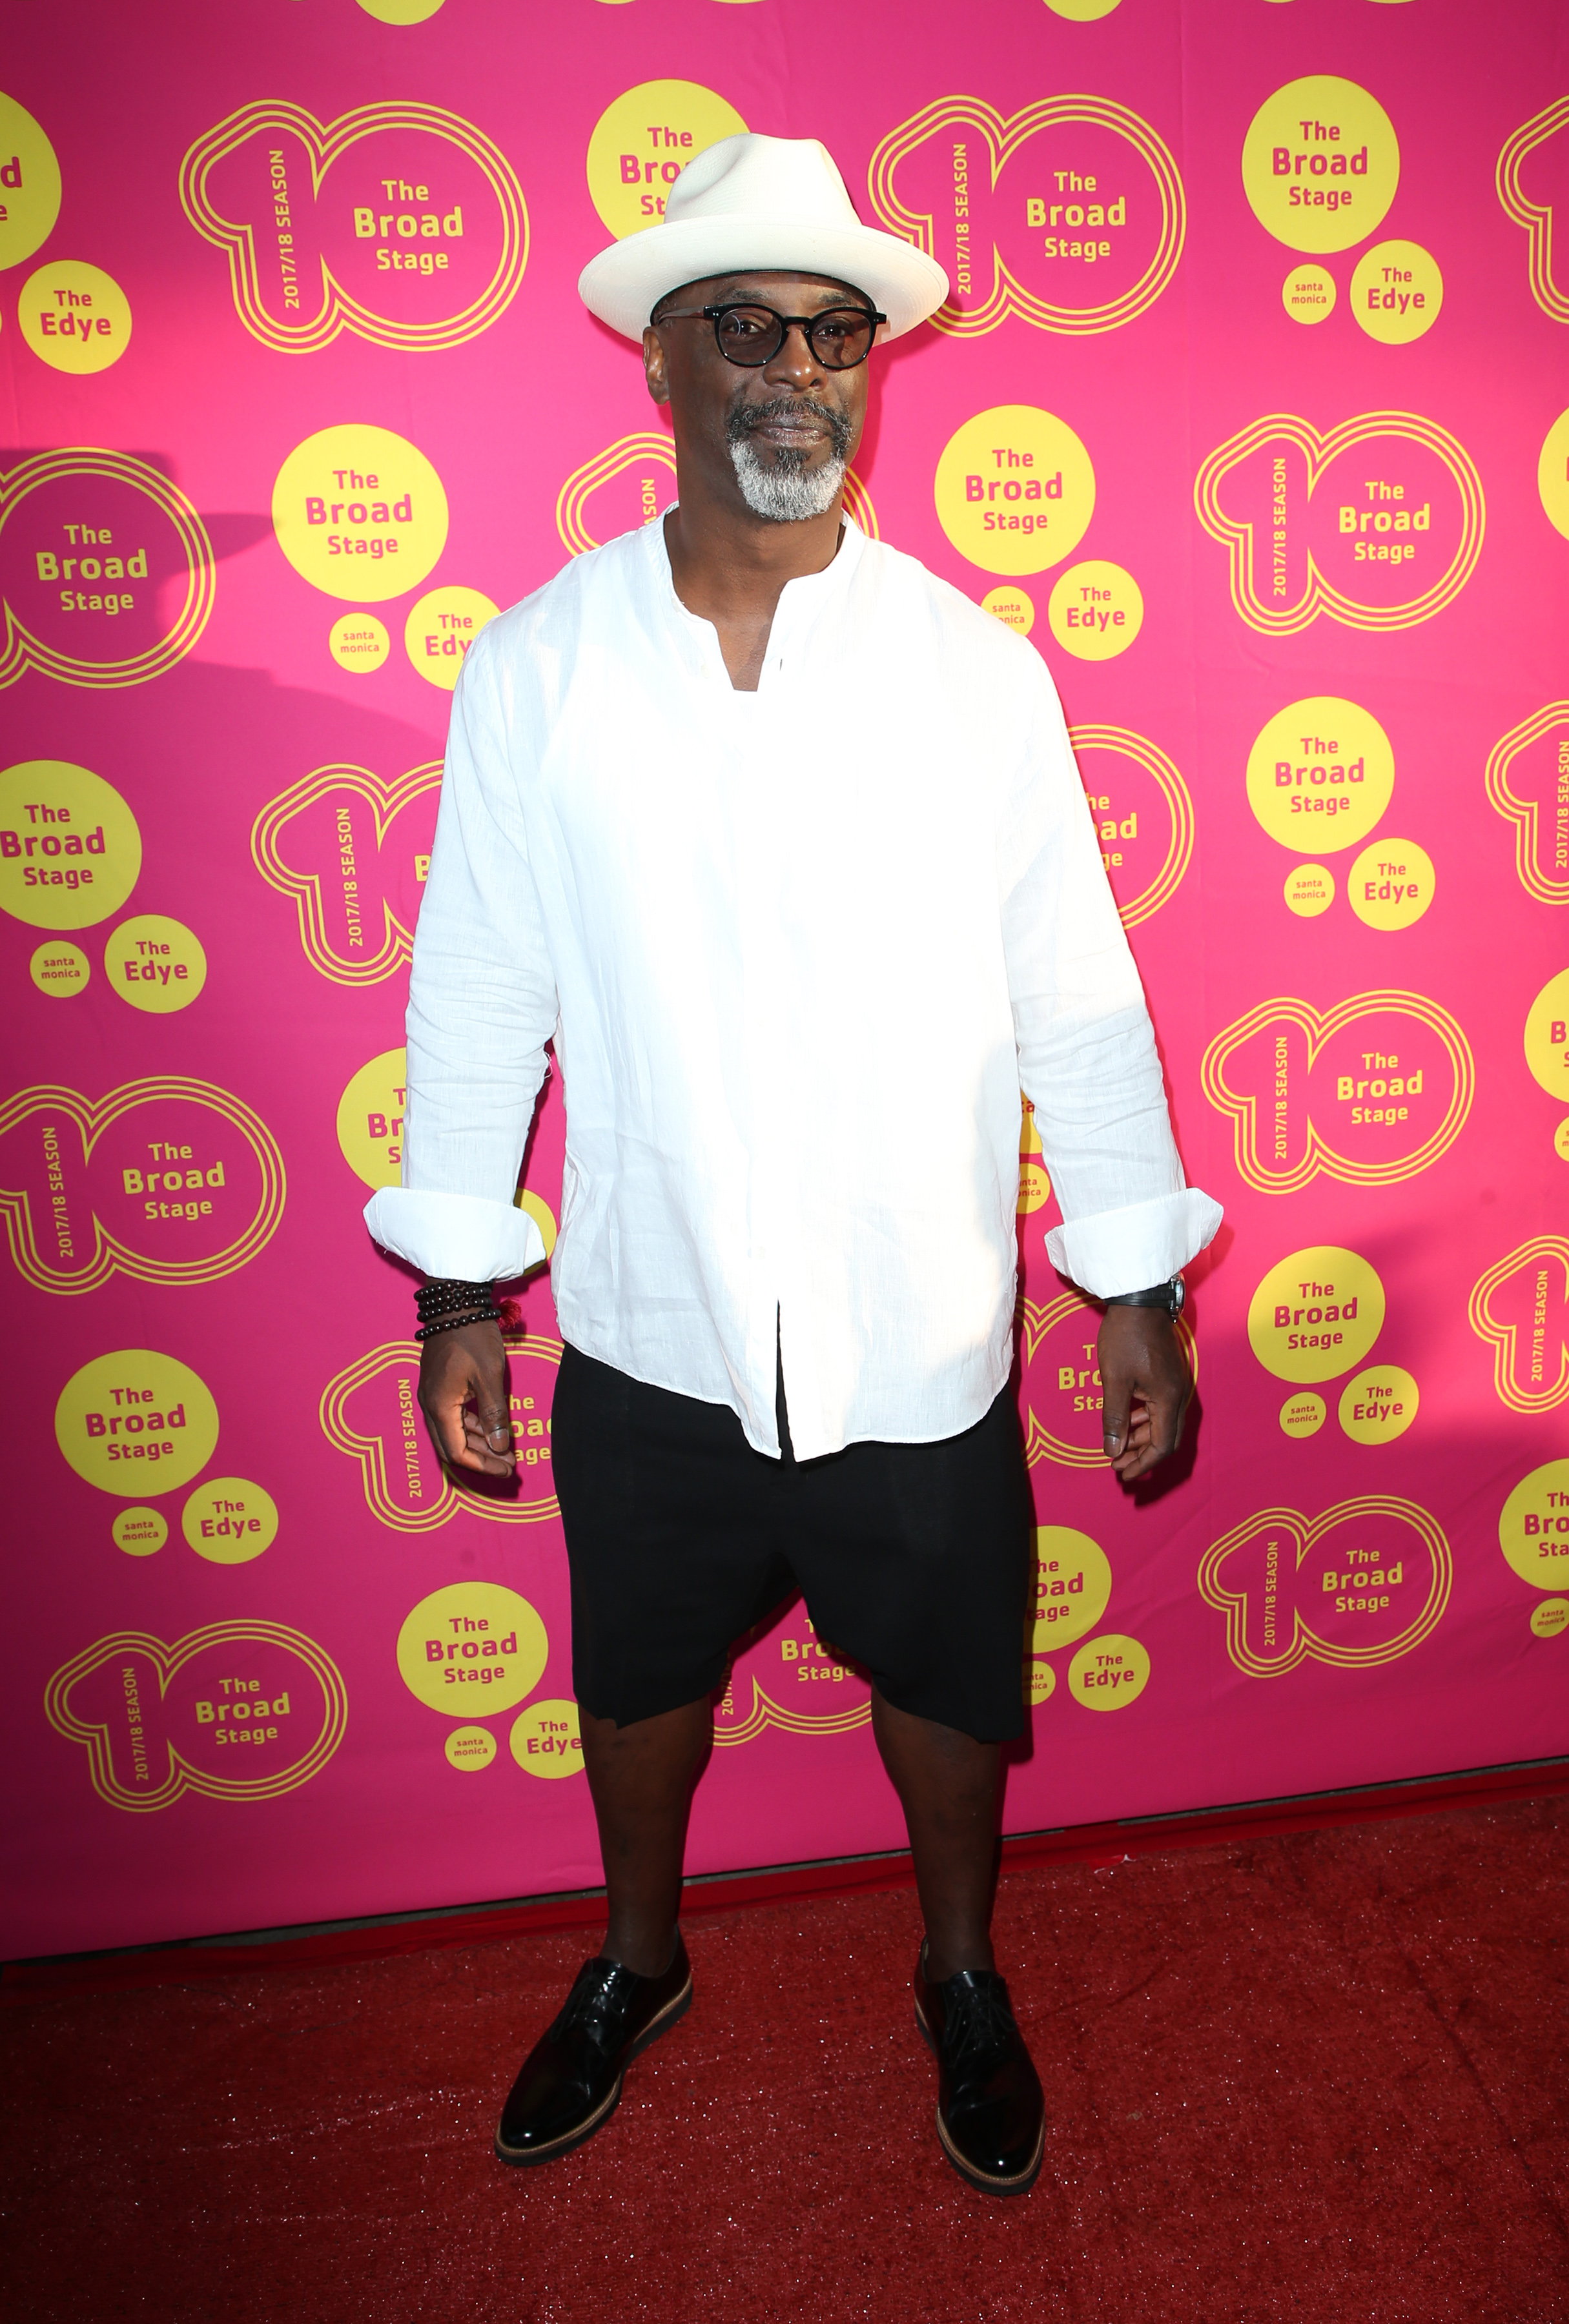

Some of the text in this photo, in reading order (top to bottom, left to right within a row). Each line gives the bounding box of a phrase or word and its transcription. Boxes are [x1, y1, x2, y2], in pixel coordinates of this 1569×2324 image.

[647, 126, 693, 148] The
[1299, 120, 1340, 141] The
[620, 154, 690, 183] Bro
[1273, 146, 1368, 176] Broad
[381, 179, 429, 201] The
[1053, 170, 1096, 192] The
[1289, 186, 1352, 211] Stage
[354, 205, 464, 238] Broad
[953, 143, 972, 295] 2017/18 SEASON
[1027, 196, 1126, 227] Broad
[269, 150, 300, 309] 2017/18 SEASON
[1045, 237, 1111, 263] Stage
[376, 249, 449, 276] Stage
[1381, 267, 1413, 283] The
[1295, 282, 1324, 292] santa
[53, 289, 92, 307] The
[1291, 294, 1327, 304] monica
[1368, 287, 1425, 315] Edye
[40, 312, 111, 342] Edye
[992, 448, 1034, 468] The
[332, 469, 379, 490] The
[965, 471, 1063, 502] Broad
[1364, 480, 1404, 500] The
[305, 493, 413, 525] Broad
[1339, 503, 1430, 533] Broad
[983, 511, 1048, 535] Stage
[1273, 458, 1286, 596] 2017/18 SEASON
[63, 524, 112, 545] The
[327, 535, 398, 559] Stage
[1354, 542, 1415, 565] Stage
[36, 548, 148, 580] Broad
[60, 591, 134, 616] Stage
[1080, 586, 1111, 602] The
[992, 603, 1021, 613] santa
[438, 613, 473, 629] The
[998, 615, 1025, 624] nica
[1067, 606, 1125, 632] Edye
[343, 631, 374, 641] santa
[340, 642, 380, 653] monica
[426, 634, 473, 661] Edy
[1300, 737, 1338, 755] The
[1275, 757, 1364, 787] Broad
[1085, 792, 1110, 810] he
[1291, 795, 1350, 816] Stage
[23, 804, 70, 824] The
[0, 826, 105, 857] Broad
[1555, 808, 1569, 868] 2017/18
[23, 866, 94, 890] Stage
[336, 808, 364, 947] 2017/18 SEASON
[1377, 862, 1406, 877] The
[1296, 879, 1323, 889] santa
[1364, 880, 1419, 904] Edye
[1292, 890, 1326, 900] monica
[135, 941, 170, 955] The
[43, 957, 75, 968] santa
[124, 959, 188, 986] Edye
[41, 968, 81, 979] monica
[1361, 1052, 1399, 1070] The
[1337, 1069, 1422, 1101] Broad
[1275, 1036, 1288, 1159] 2017/18 SEASON
[1351, 1106, 1408, 1126] Stage
[147, 1142, 192, 1161] The
[123, 1161, 225, 1194] Broad
[42, 1126, 74, 1258] 2017/18 SEASON
[145, 1201, 212, 1221] Stage
[1298, 1281, 1335, 1299] The
[1275, 1296, 1358, 1328] Broad
[1531, 1270, 1548, 1381] 2017/18 SEASON
[1287, 1332, 1343, 1351] Stage
[109, 1387, 154, 1406] The
[509, 1394, 535, 1410] he
[1366, 1386, 1393, 1399] The
[1287, 1414, 1318, 1424] monica
[1291, 1405, 1315, 1414] santa
[1353, 1401, 1403, 1422] Edye
[85, 1403, 186, 1438] Broad
[397, 1378, 422, 1498] 2017/18 SEASON
[107, 1442, 174, 1461] Stage
[515, 1447, 551, 1465] age
[212, 1500, 245, 1514] The
[1547, 1492, 1569, 1507] Th
[124, 1521, 154, 1531] santa
[200, 1516, 261, 1539] Edye
[1524, 1514, 1569, 1535] Bro
[121, 1531, 159, 1541] monica
[1346, 1549, 1380, 1565] The
[1539, 1542, 1569, 1557] Sta
[1032, 1572, 1083, 1598] oad
[1322, 1561, 1403, 1592] Broad
[1264, 1541, 1278, 1646] 2017/18 SEASON
[1335, 1596, 1390, 1613] Stage
[1541, 1609, 1564, 1618] santa
[449, 1616, 489, 1633] The
[1537, 1616, 1565, 1626] monica
[426, 1631, 518, 1662] Broad
[1095, 1655, 1123, 1667] The
[444, 1667, 505, 1684] Stage
[1083, 1669, 1134, 1689] Edye
[218, 1677, 260, 1695] The
[196, 1691, 291, 1724] Broad
[121, 1667, 149, 1781] 2017/18 SEASON
[538, 1720, 568, 1733] The
[215, 1727, 278, 1745] Stage
[456, 1738, 484, 1747] santa
[528, 1736, 582, 1755] Edye
[453, 1747, 488, 1757] monica
